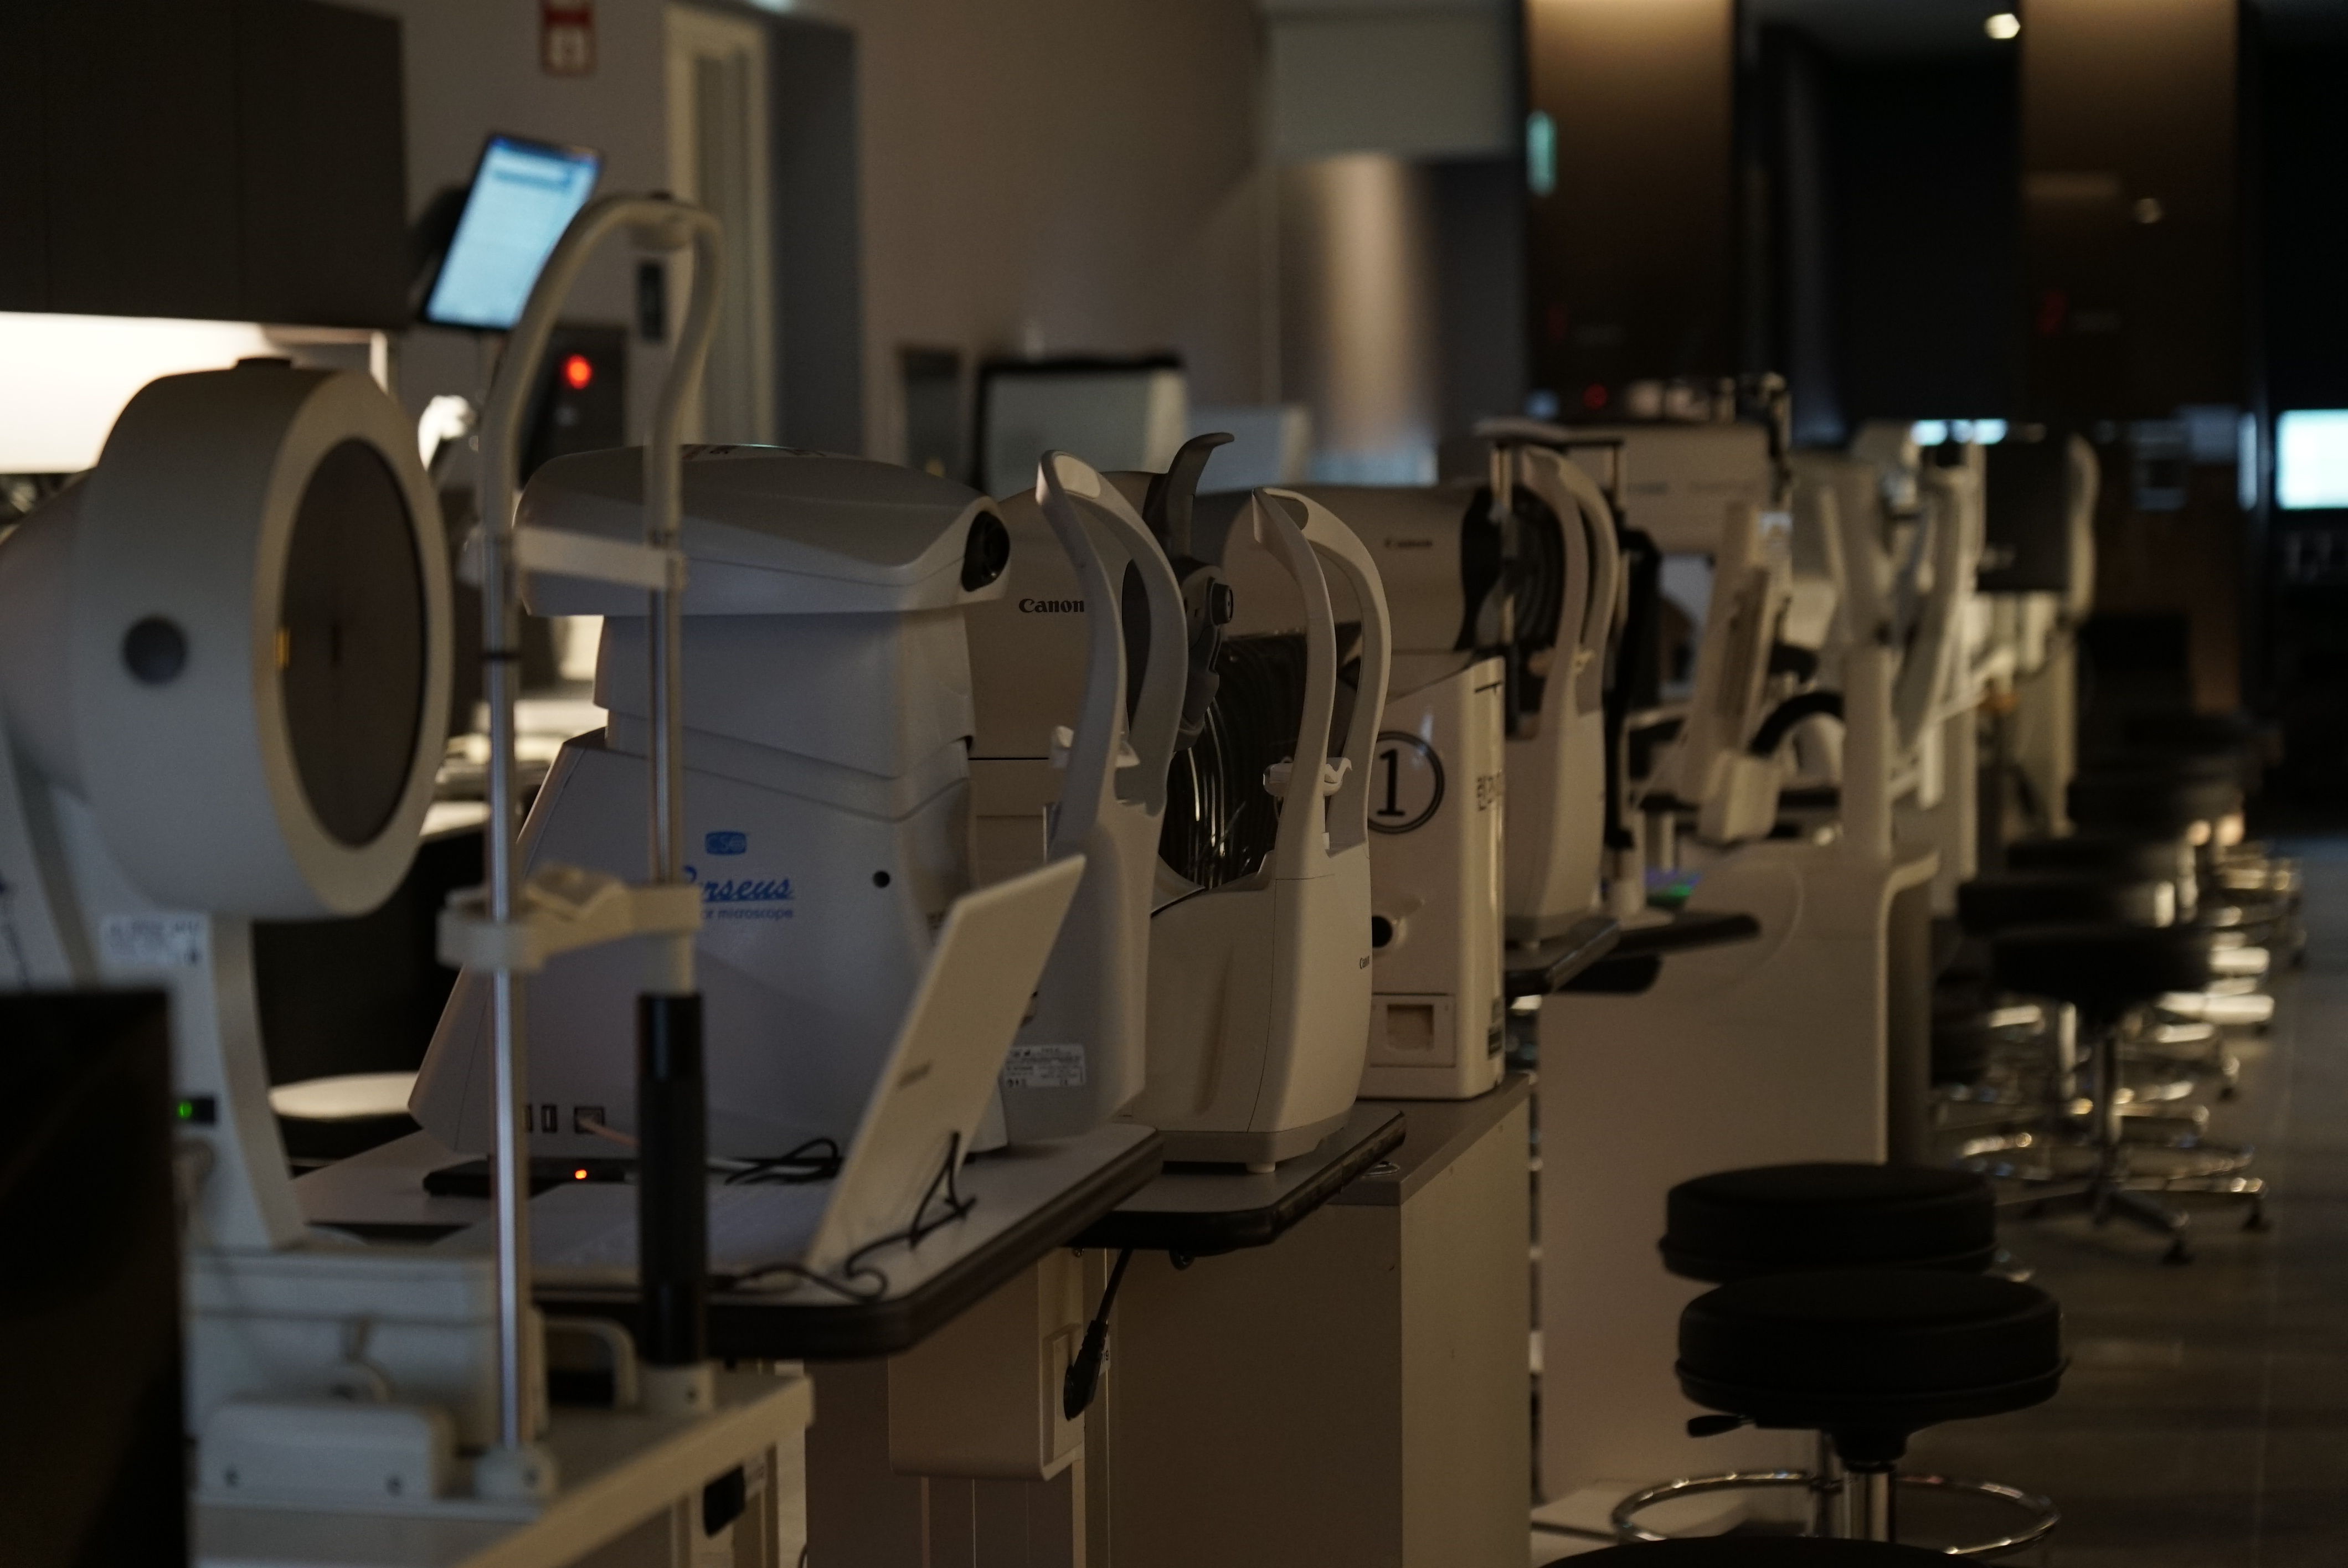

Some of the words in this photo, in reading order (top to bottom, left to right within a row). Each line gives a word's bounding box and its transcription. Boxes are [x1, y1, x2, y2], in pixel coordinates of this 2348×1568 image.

[1019, 599, 1084, 613] Canon
[1377, 749, 1405, 816] 1
[683, 865, 793, 901] rseus
[718, 908, 793, 921] microscope
